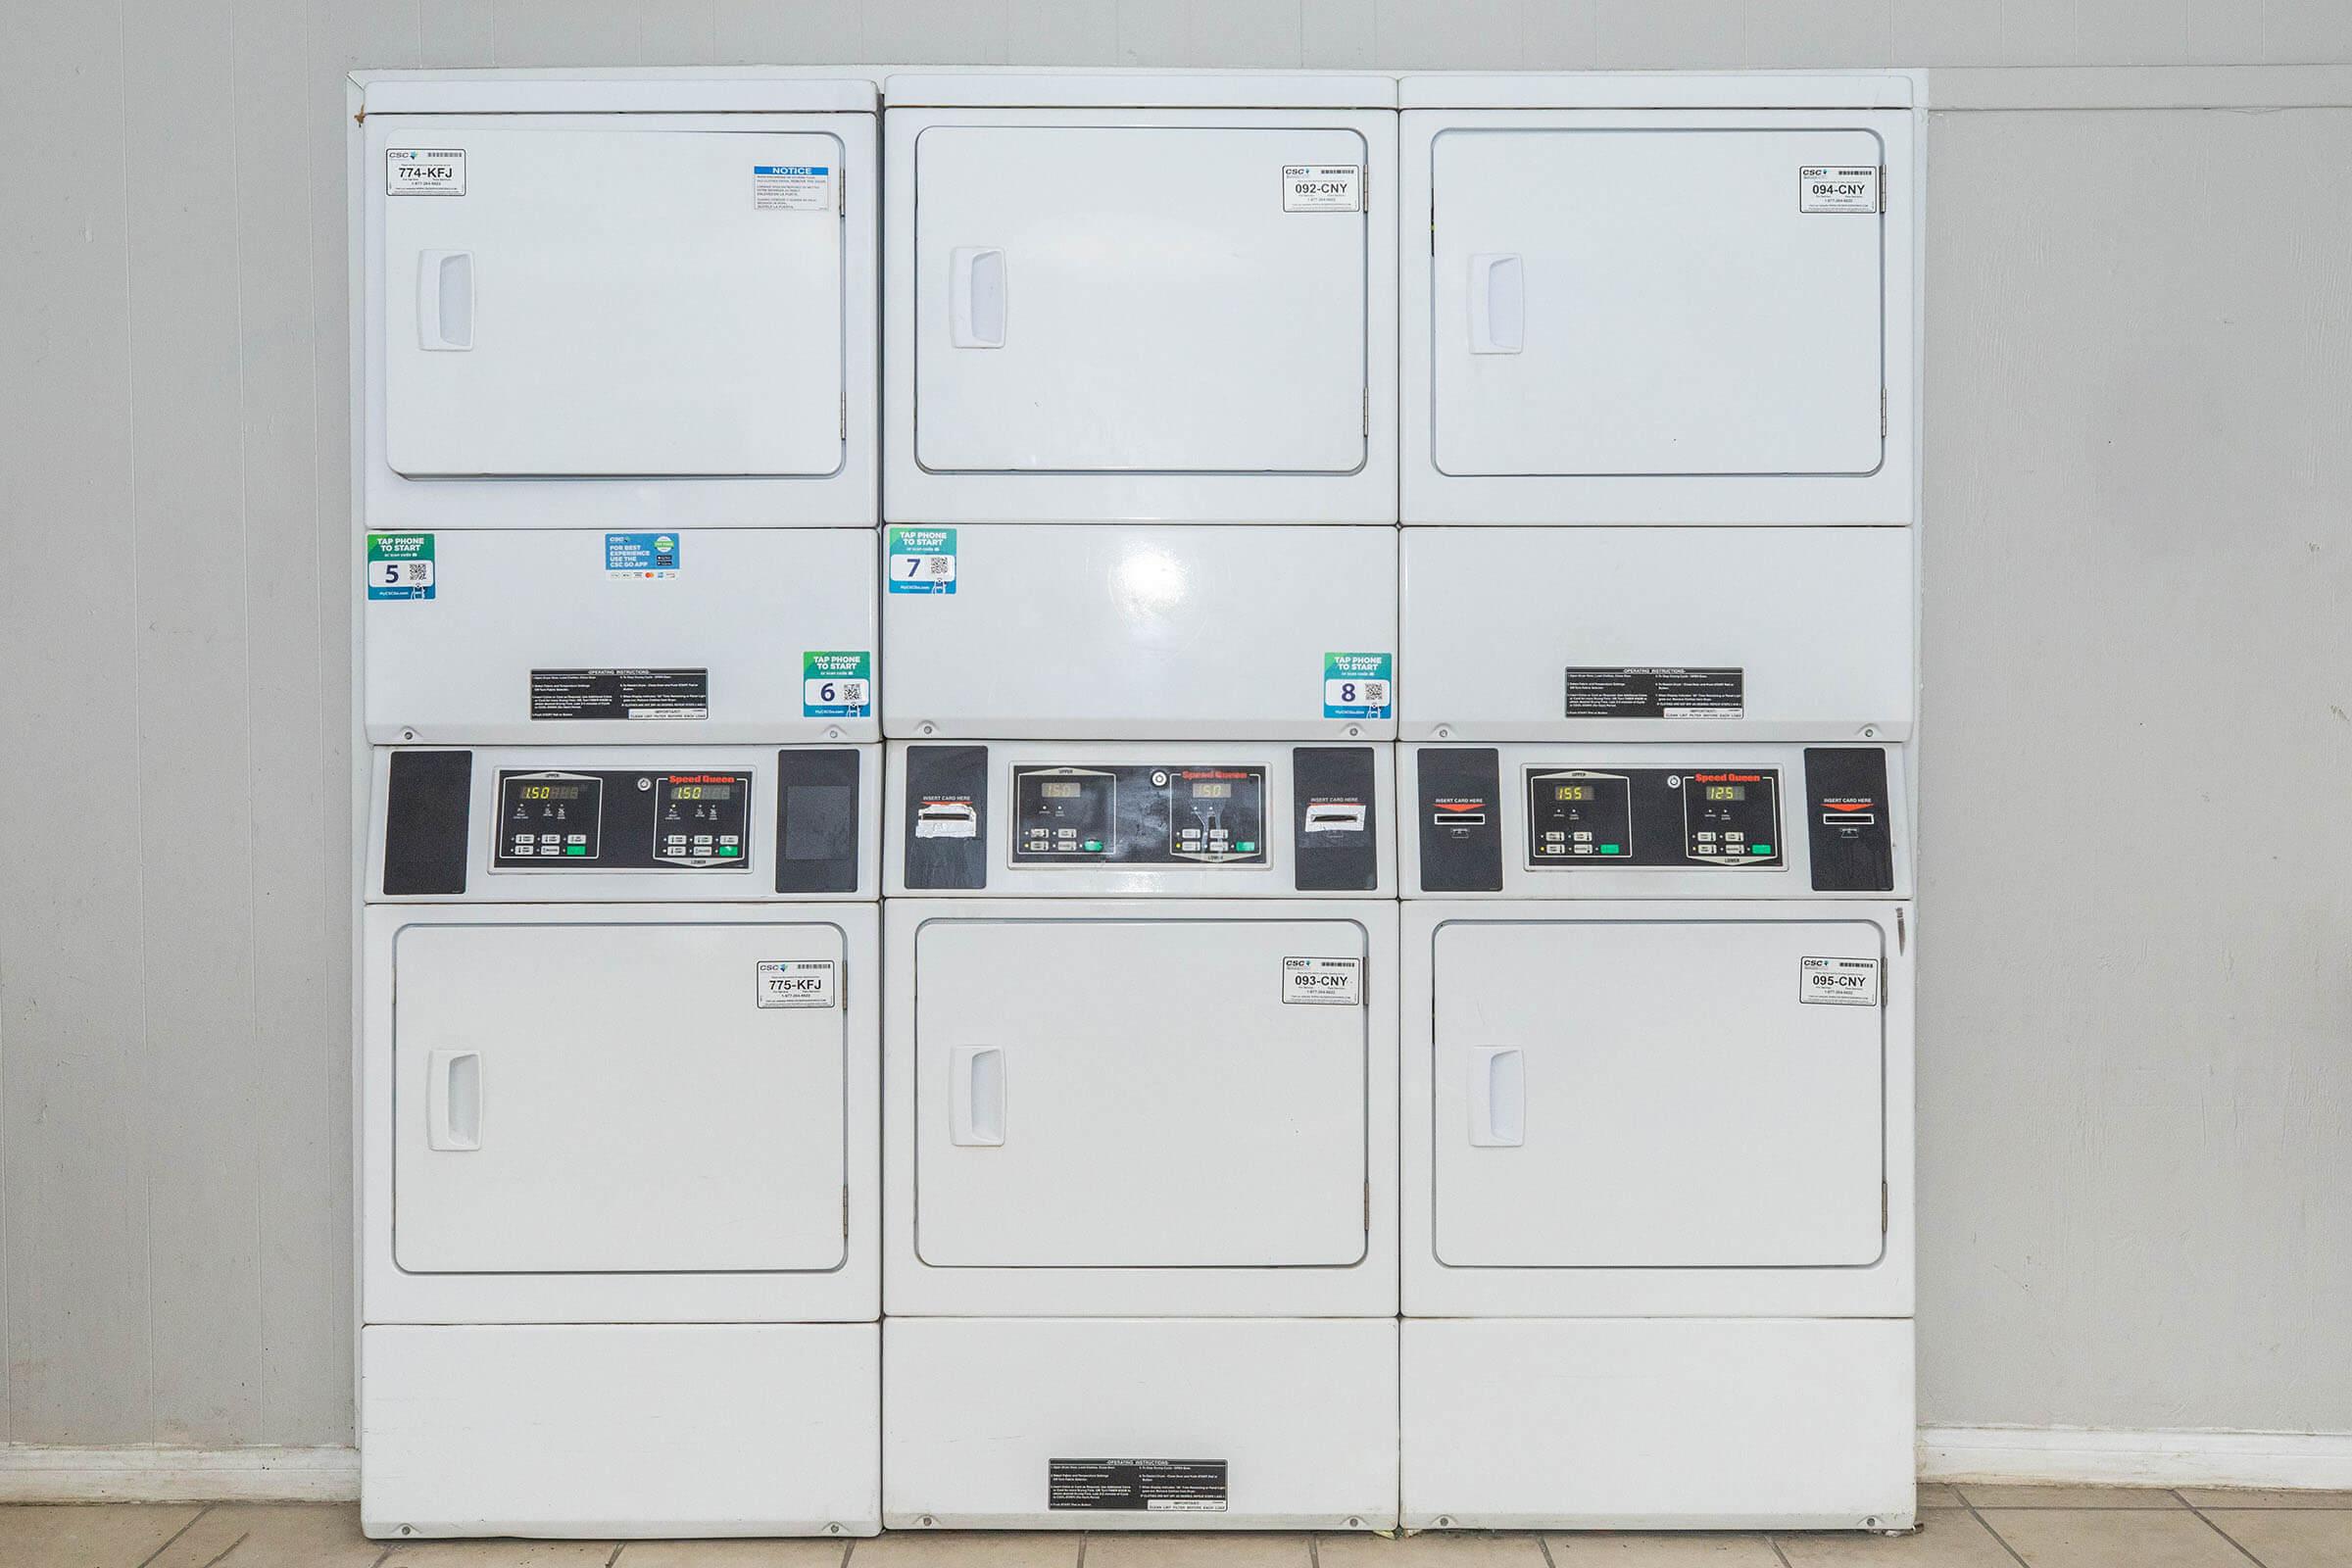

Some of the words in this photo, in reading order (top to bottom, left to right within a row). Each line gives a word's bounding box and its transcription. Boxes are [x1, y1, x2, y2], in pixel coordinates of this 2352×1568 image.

[398, 168, 452, 178] 774-KFJ
[1295, 183, 1347, 193] 092-CNY
[1812, 185, 1865, 194] 094-CNY
[907, 558, 921, 577] 7
[385, 564, 399, 583] 5
[821, 683, 835, 701] 6
[1341, 683, 1356, 702] 8
[670, 775, 701, 784] Speed
[1182, 771, 1214, 780] Speed
[1695, 773, 1727, 782] Speed
[769, 980, 821, 990] 775-KFJ
[1295, 976, 1348, 986] 093-CNY
[1813, 976, 1866, 986] 095-CNY
